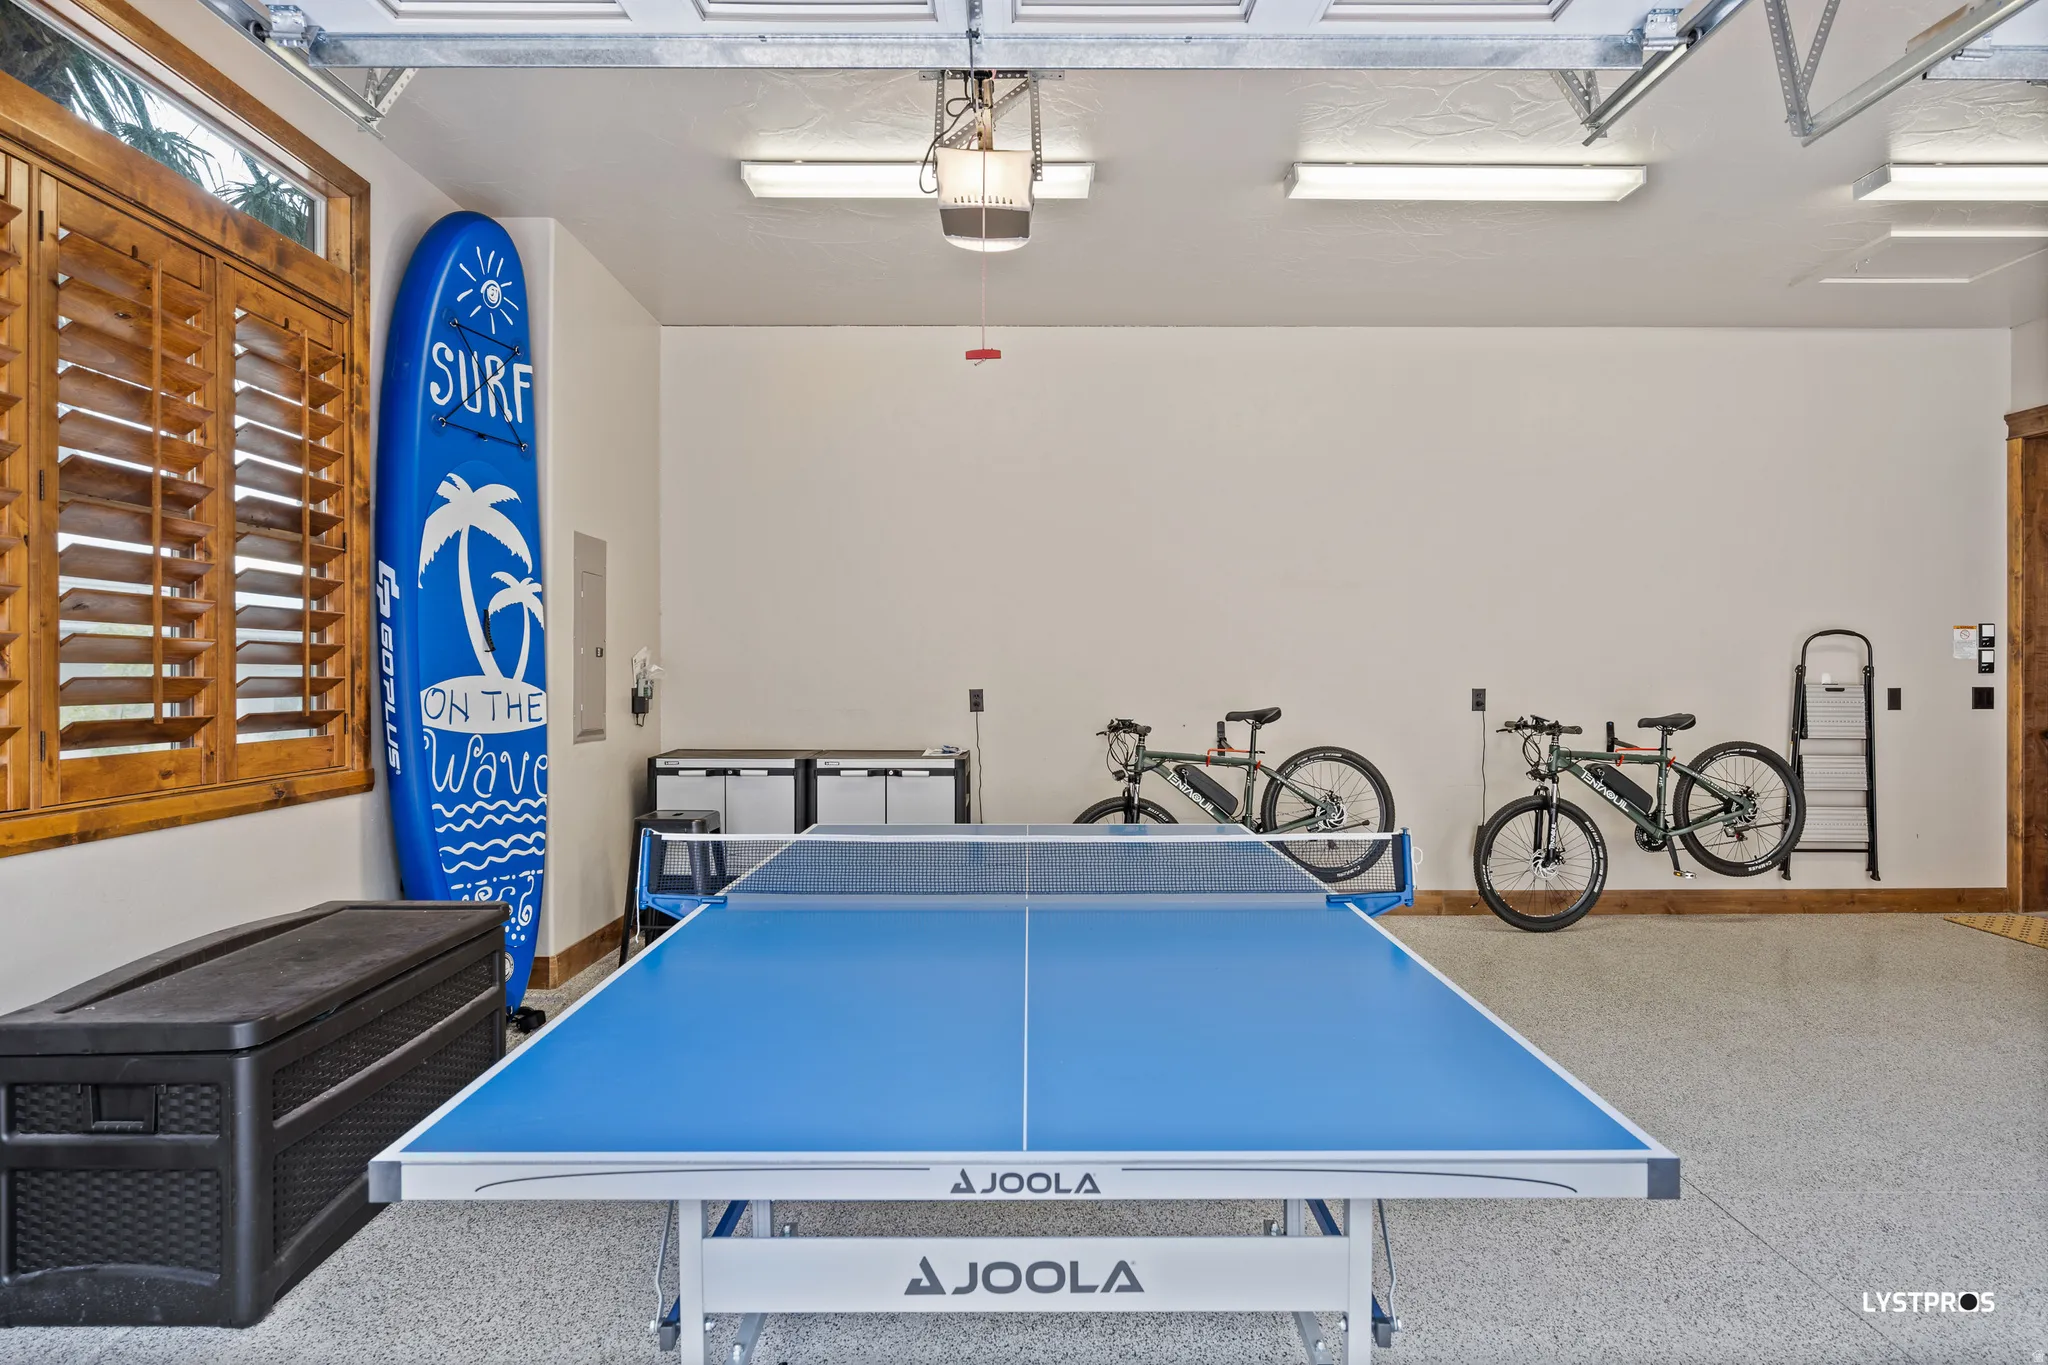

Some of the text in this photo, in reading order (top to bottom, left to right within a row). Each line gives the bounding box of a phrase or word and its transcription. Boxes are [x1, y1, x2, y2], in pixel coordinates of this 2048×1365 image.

[430, 341, 533, 424] SURF
[380, 622, 401, 771] GOPLUS
[424, 687, 543, 725] ON THE
[979, 1172, 1102, 1194] JOOLA
[951, 1260, 1146, 1295] JOOLA
